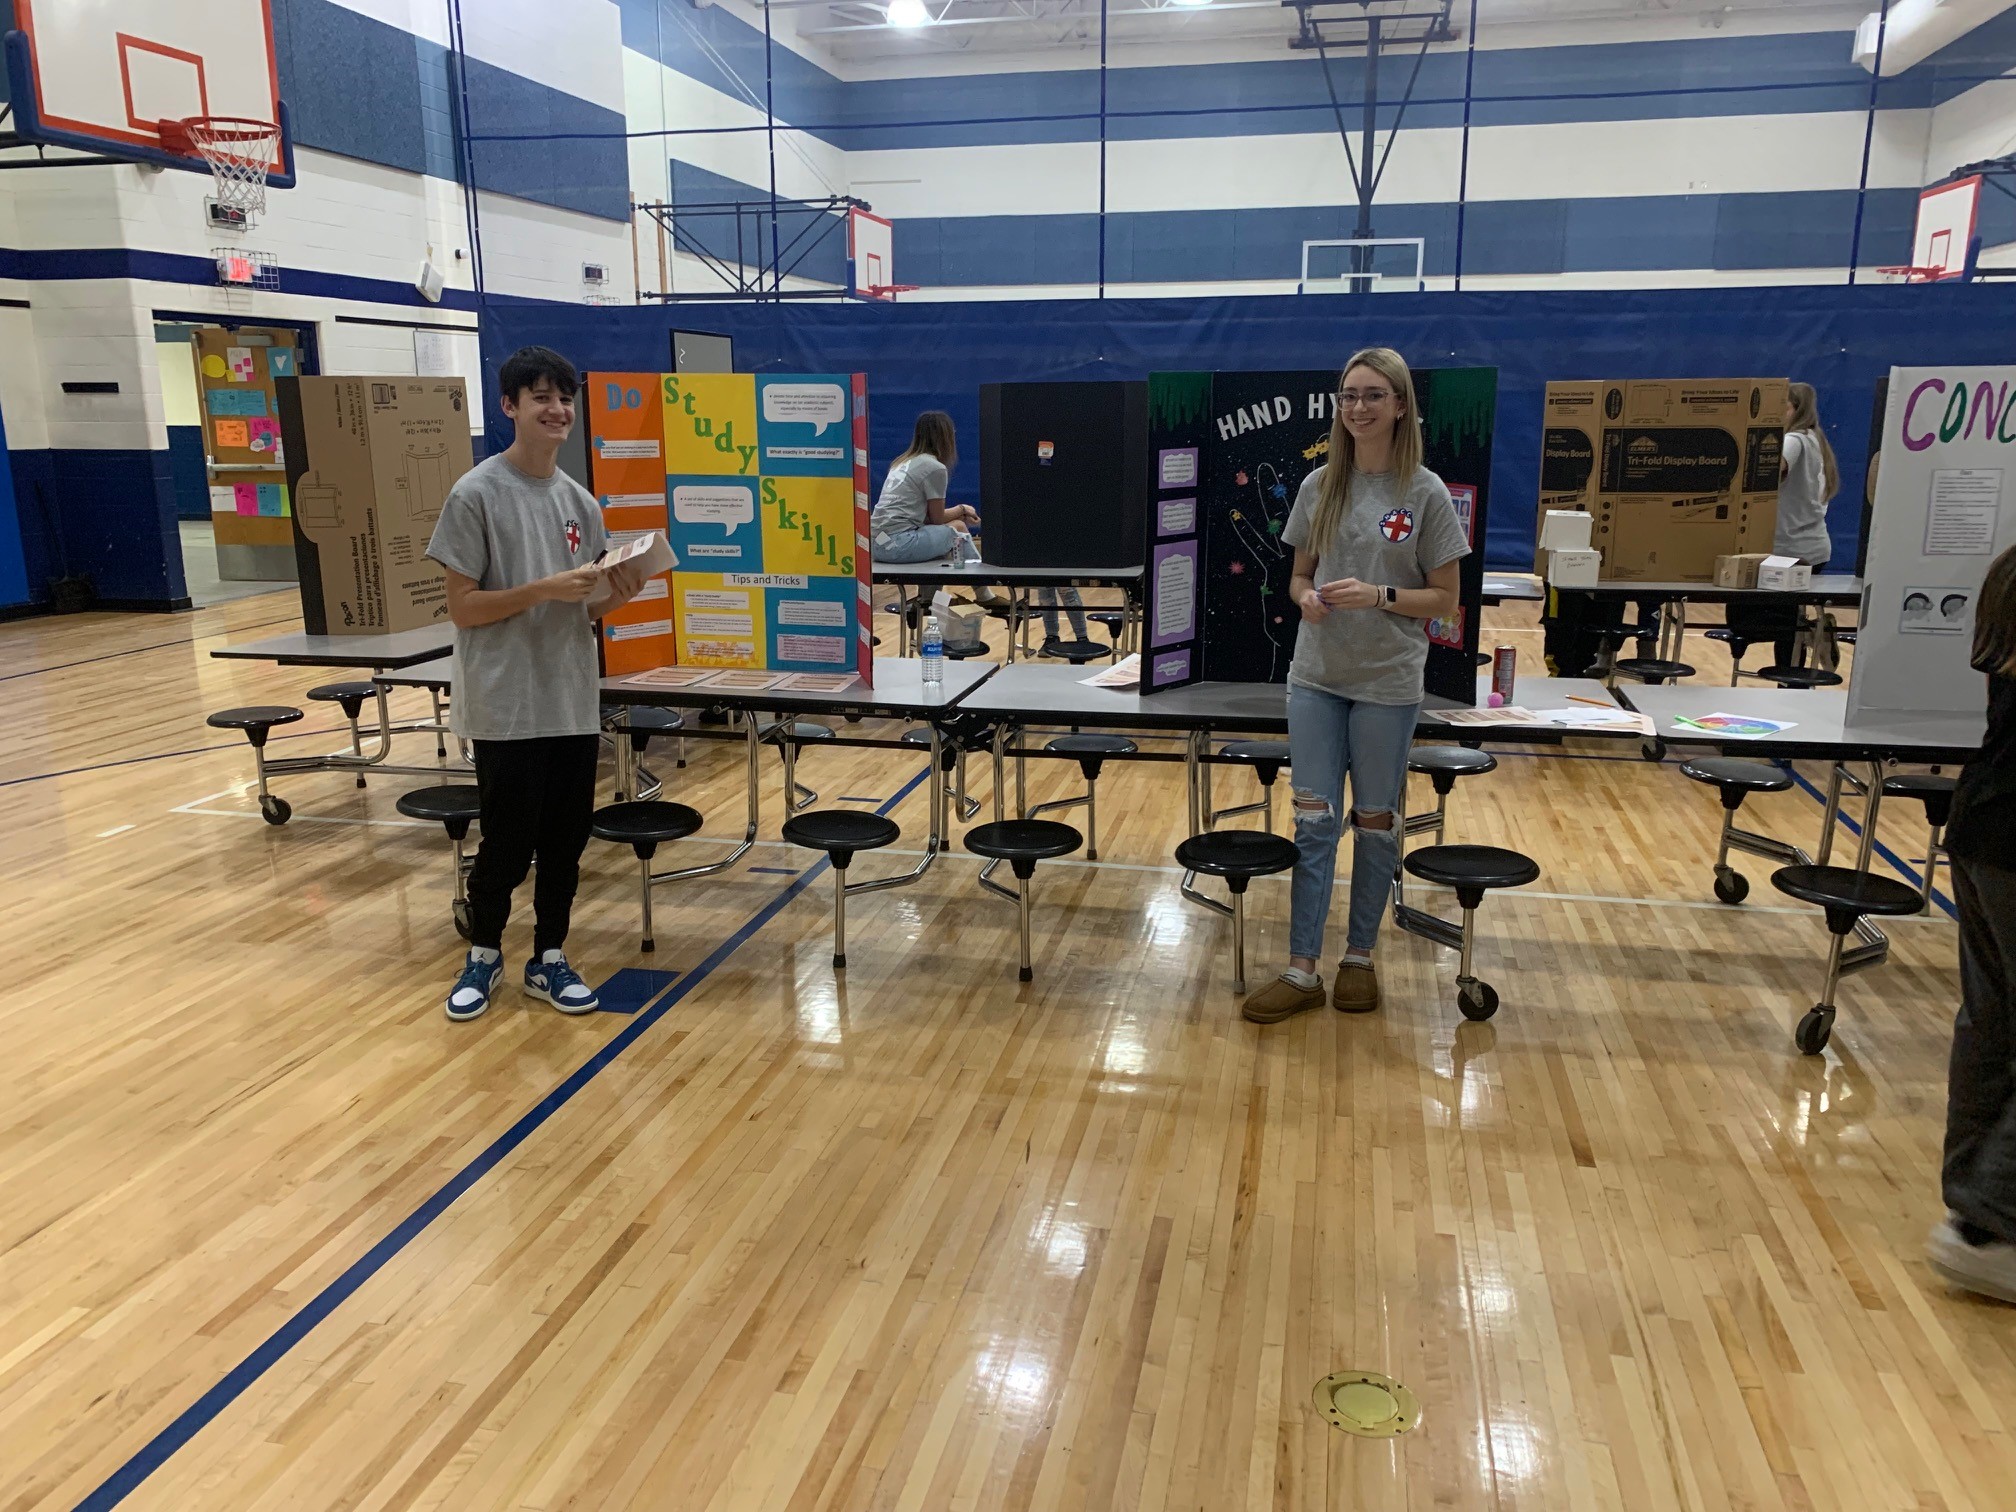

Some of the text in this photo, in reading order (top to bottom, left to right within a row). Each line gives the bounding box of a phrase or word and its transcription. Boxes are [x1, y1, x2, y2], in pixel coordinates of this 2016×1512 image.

[606, 383, 642, 411] Do
[664, 377, 757, 474] Study
[1216, 396, 1292, 441] HAND
[1546, 449, 1591, 458] Display Board
[1627, 456, 1728, 467] Tri-Fold Display Board
[367, 508, 375, 536] battants
[761, 477, 855, 575] Skills
[361, 533, 372, 584] presentaciones
[350, 536, 366, 627] Tri-Fold Presentation Board
[366, 585, 374, 601] para
[372, 561, 381, 597] d'affichage
[731, 574, 800, 586] Tips and Tricks
[376, 598, 384, 627] Panneau
